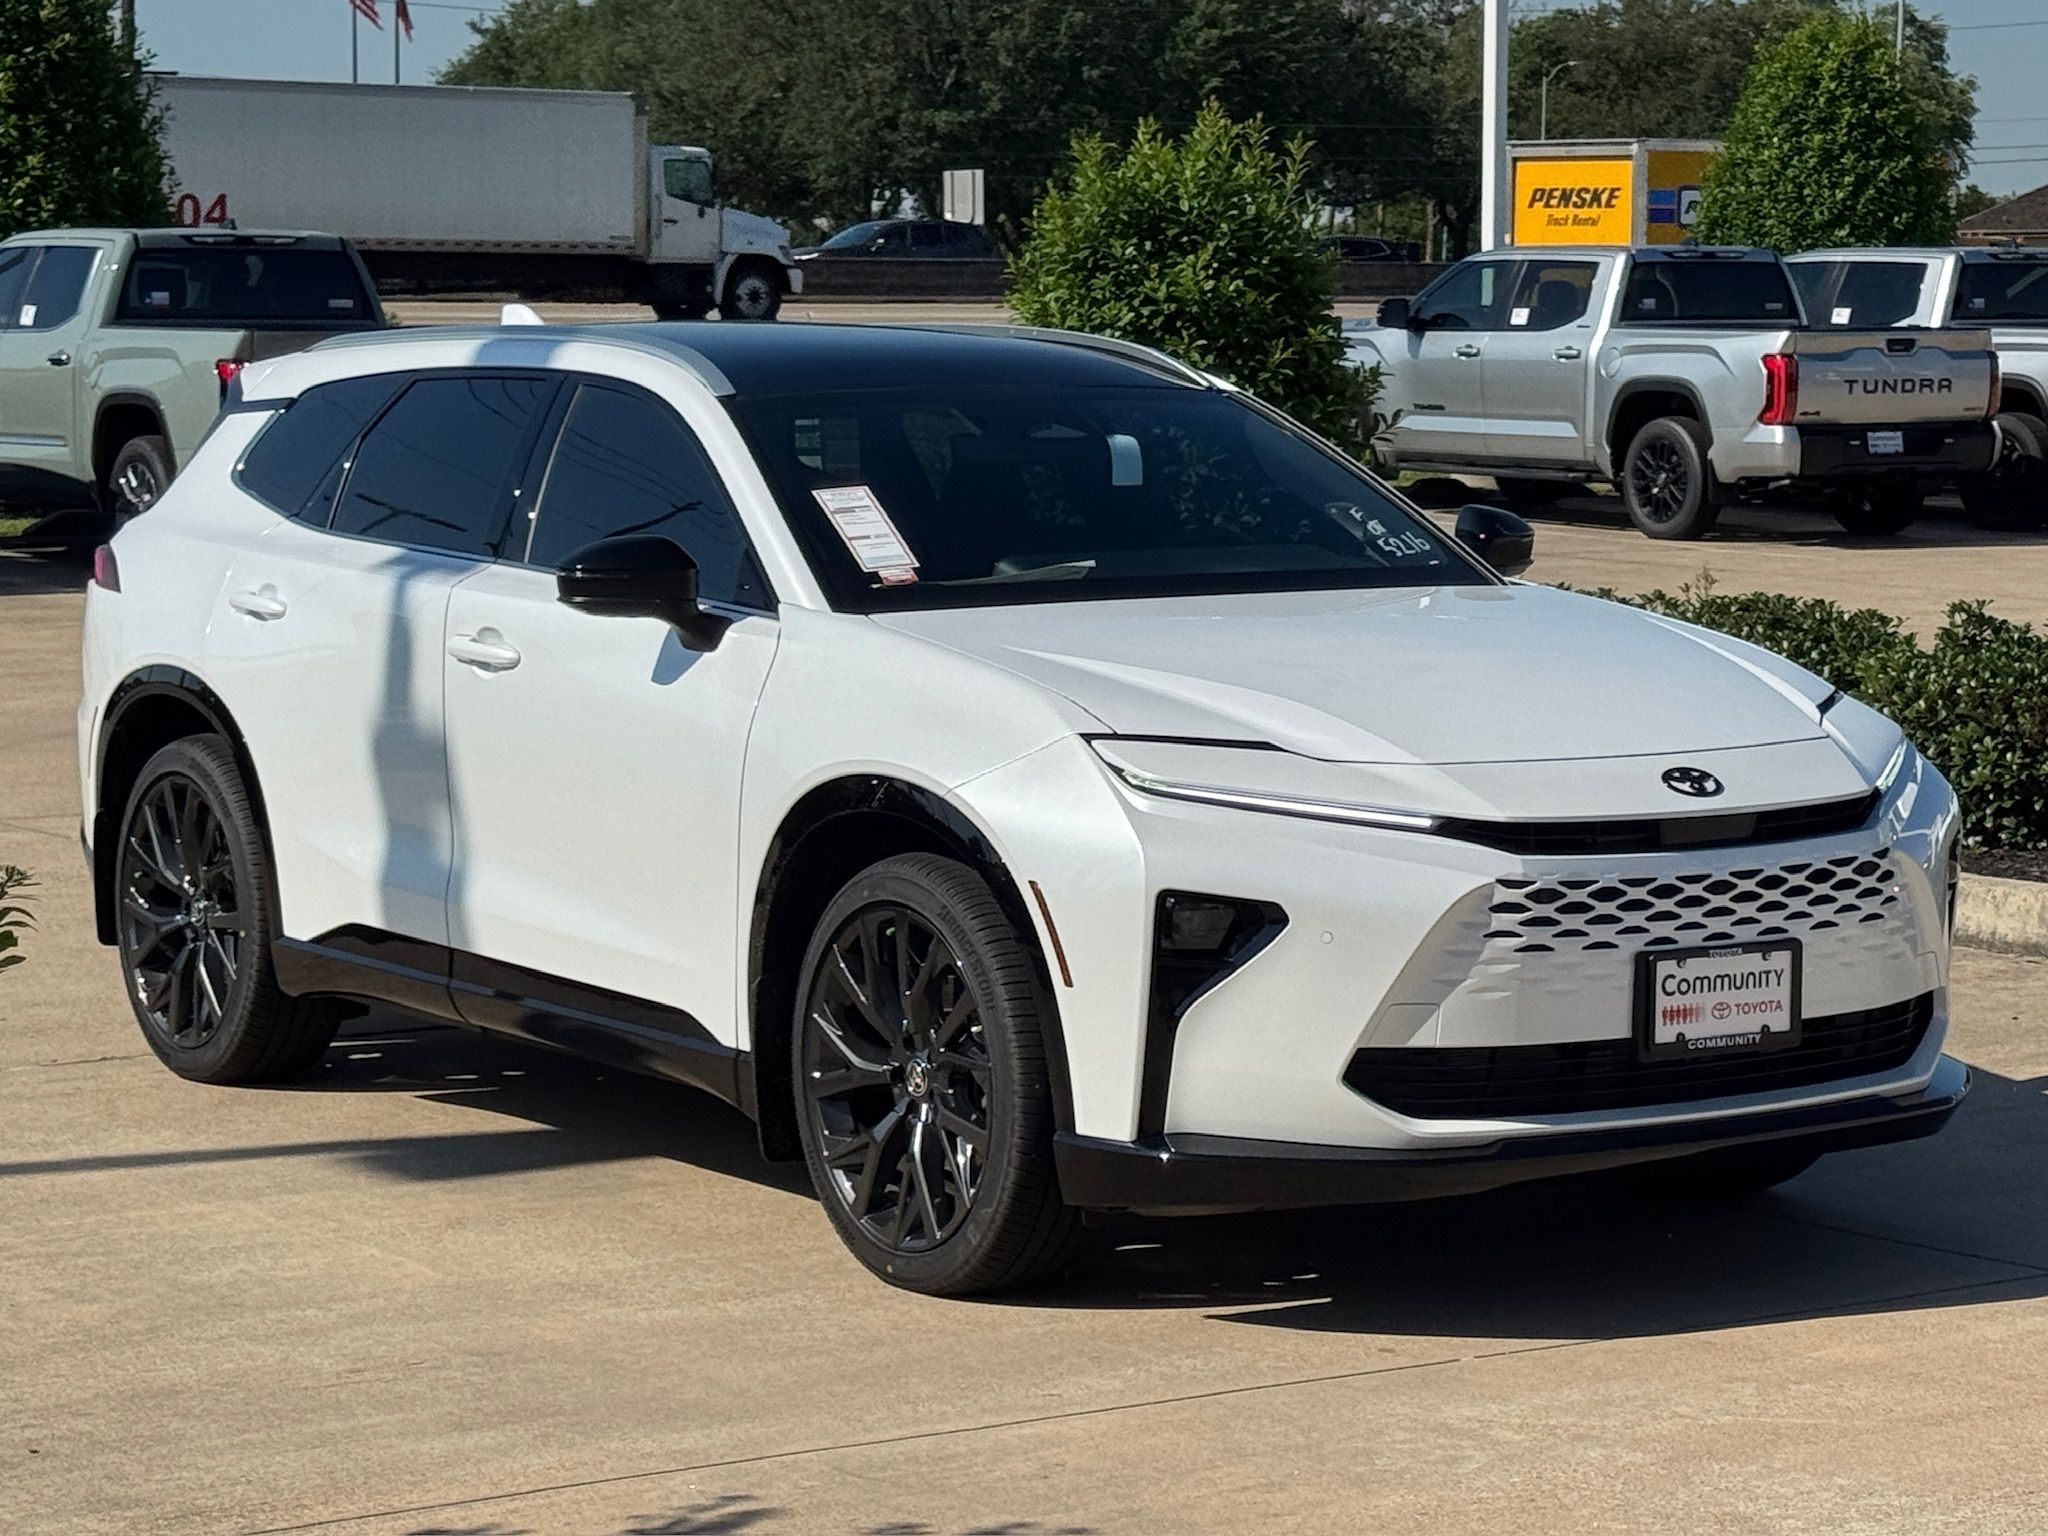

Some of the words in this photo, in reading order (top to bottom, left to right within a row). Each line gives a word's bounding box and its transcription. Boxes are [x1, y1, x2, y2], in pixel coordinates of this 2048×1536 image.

[1527, 186, 1623, 210] PENSKE
[1844, 377, 1953, 395] TUNDRA
[1376, 530, 1432, 557] 5216
[1734, 1000, 1784, 1016] TOYOTA
[1687, 1033, 1762, 1050] COMMUNITY
